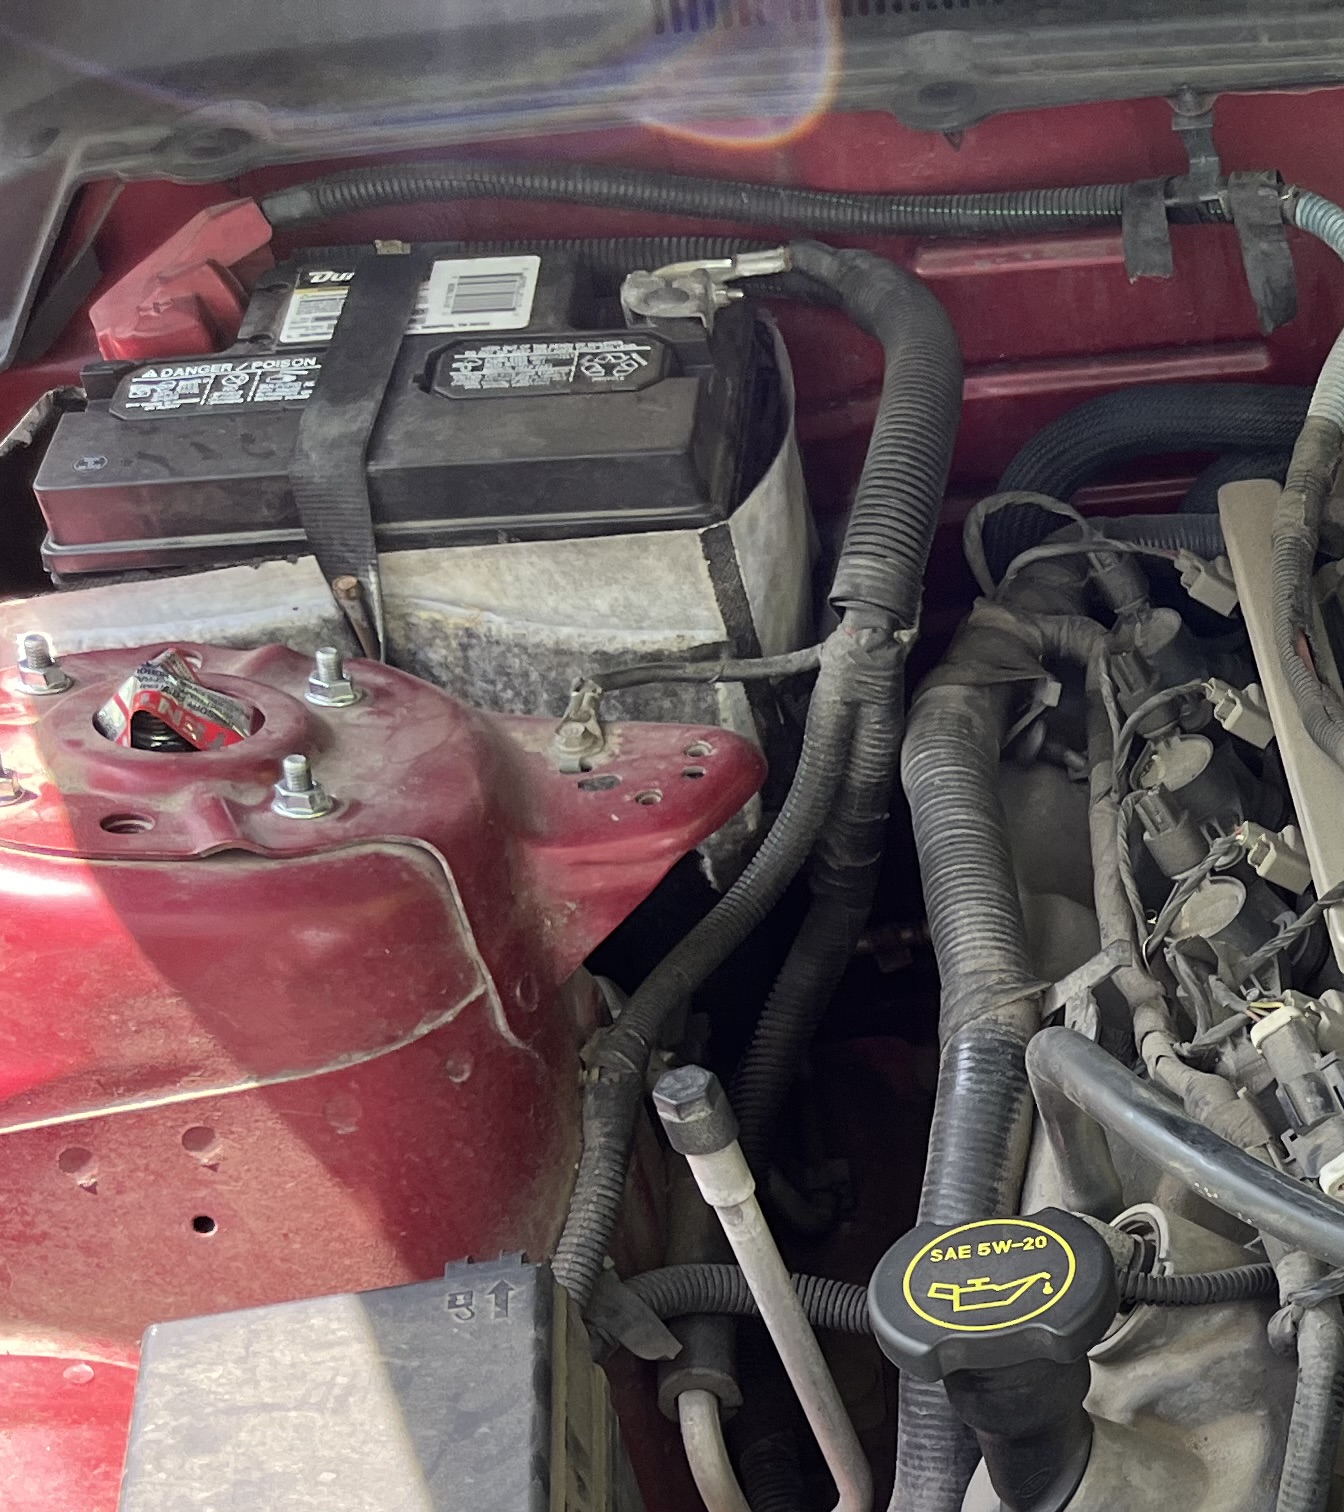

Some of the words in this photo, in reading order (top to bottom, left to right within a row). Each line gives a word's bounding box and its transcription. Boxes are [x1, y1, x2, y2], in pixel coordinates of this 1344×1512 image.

[160, 363, 233, 378] DANGER
[251, 357, 317, 370] POISON
[930, 1244, 972, 1262] SAE
[977, 1235, 1048, 1257] 5W-20
